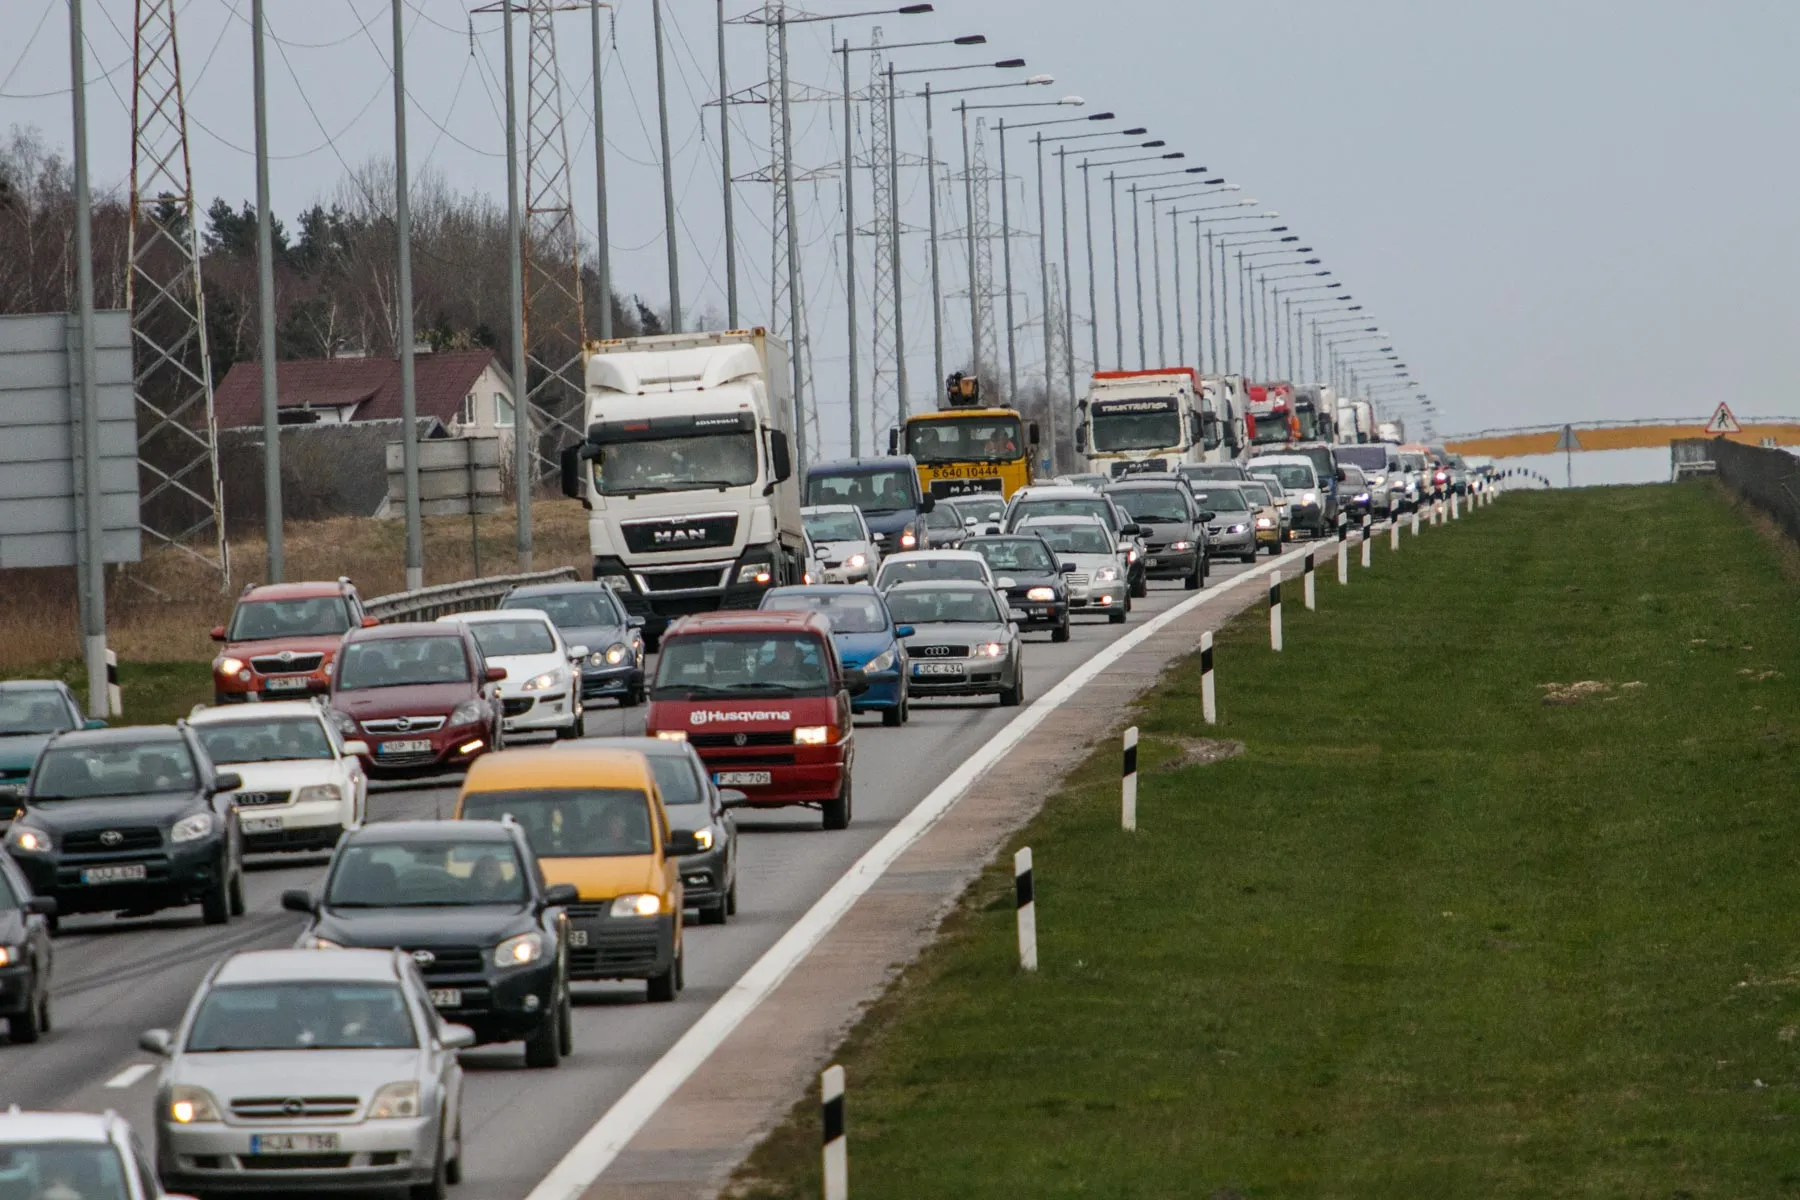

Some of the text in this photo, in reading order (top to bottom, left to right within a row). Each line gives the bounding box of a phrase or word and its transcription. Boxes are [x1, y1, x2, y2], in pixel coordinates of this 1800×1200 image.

[942, 468, 962, 478] 640
[966, 467, 998, 477] 10444
[950, 485, 982, 493] MAN
[654, 529, 705, 542] MAN
[708, 711, 791, 722] Husqvarna
[747, 772, 769, 783] 709
